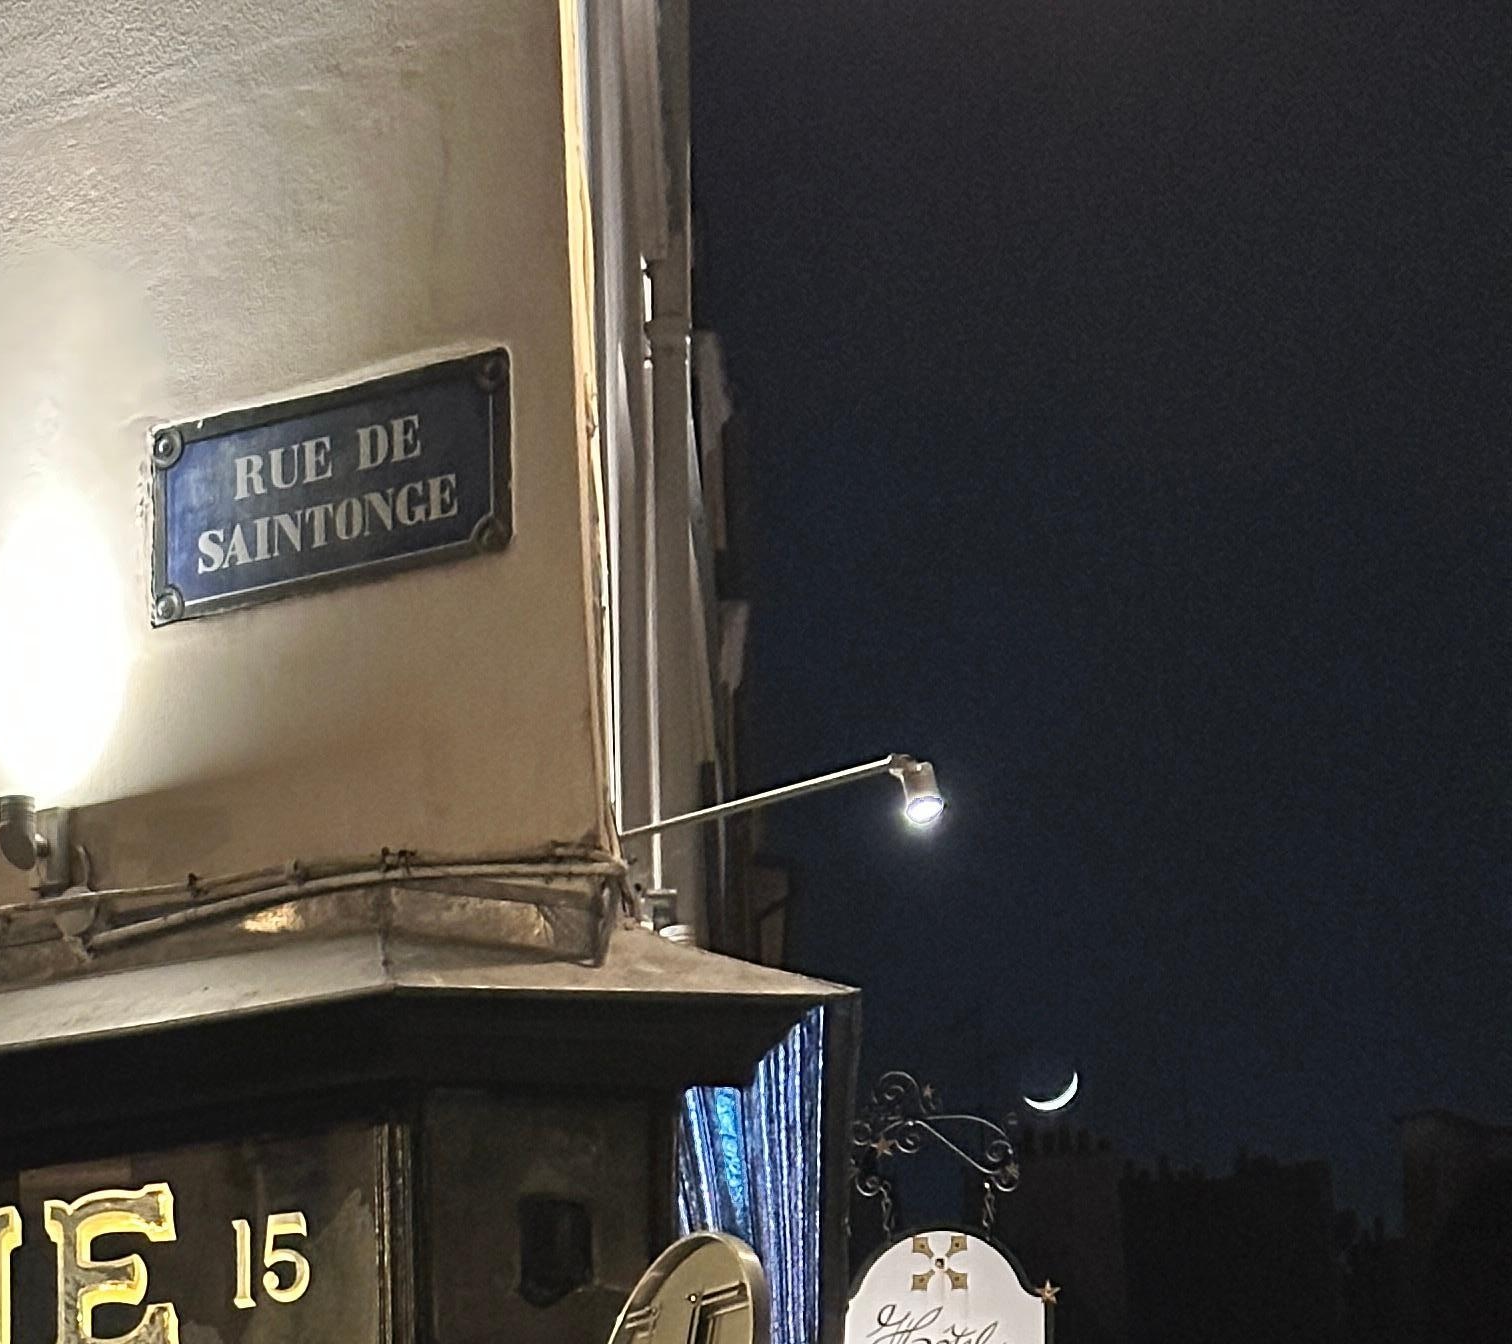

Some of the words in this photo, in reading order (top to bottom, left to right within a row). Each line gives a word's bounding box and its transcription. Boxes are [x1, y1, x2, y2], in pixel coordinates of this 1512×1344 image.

[234, 436, 332, 500] RUE
[357, 414, 421, 471] DE
[197, 474, 458, 574] SAINTONGE
[231, 1212, 311, 1308] 15
